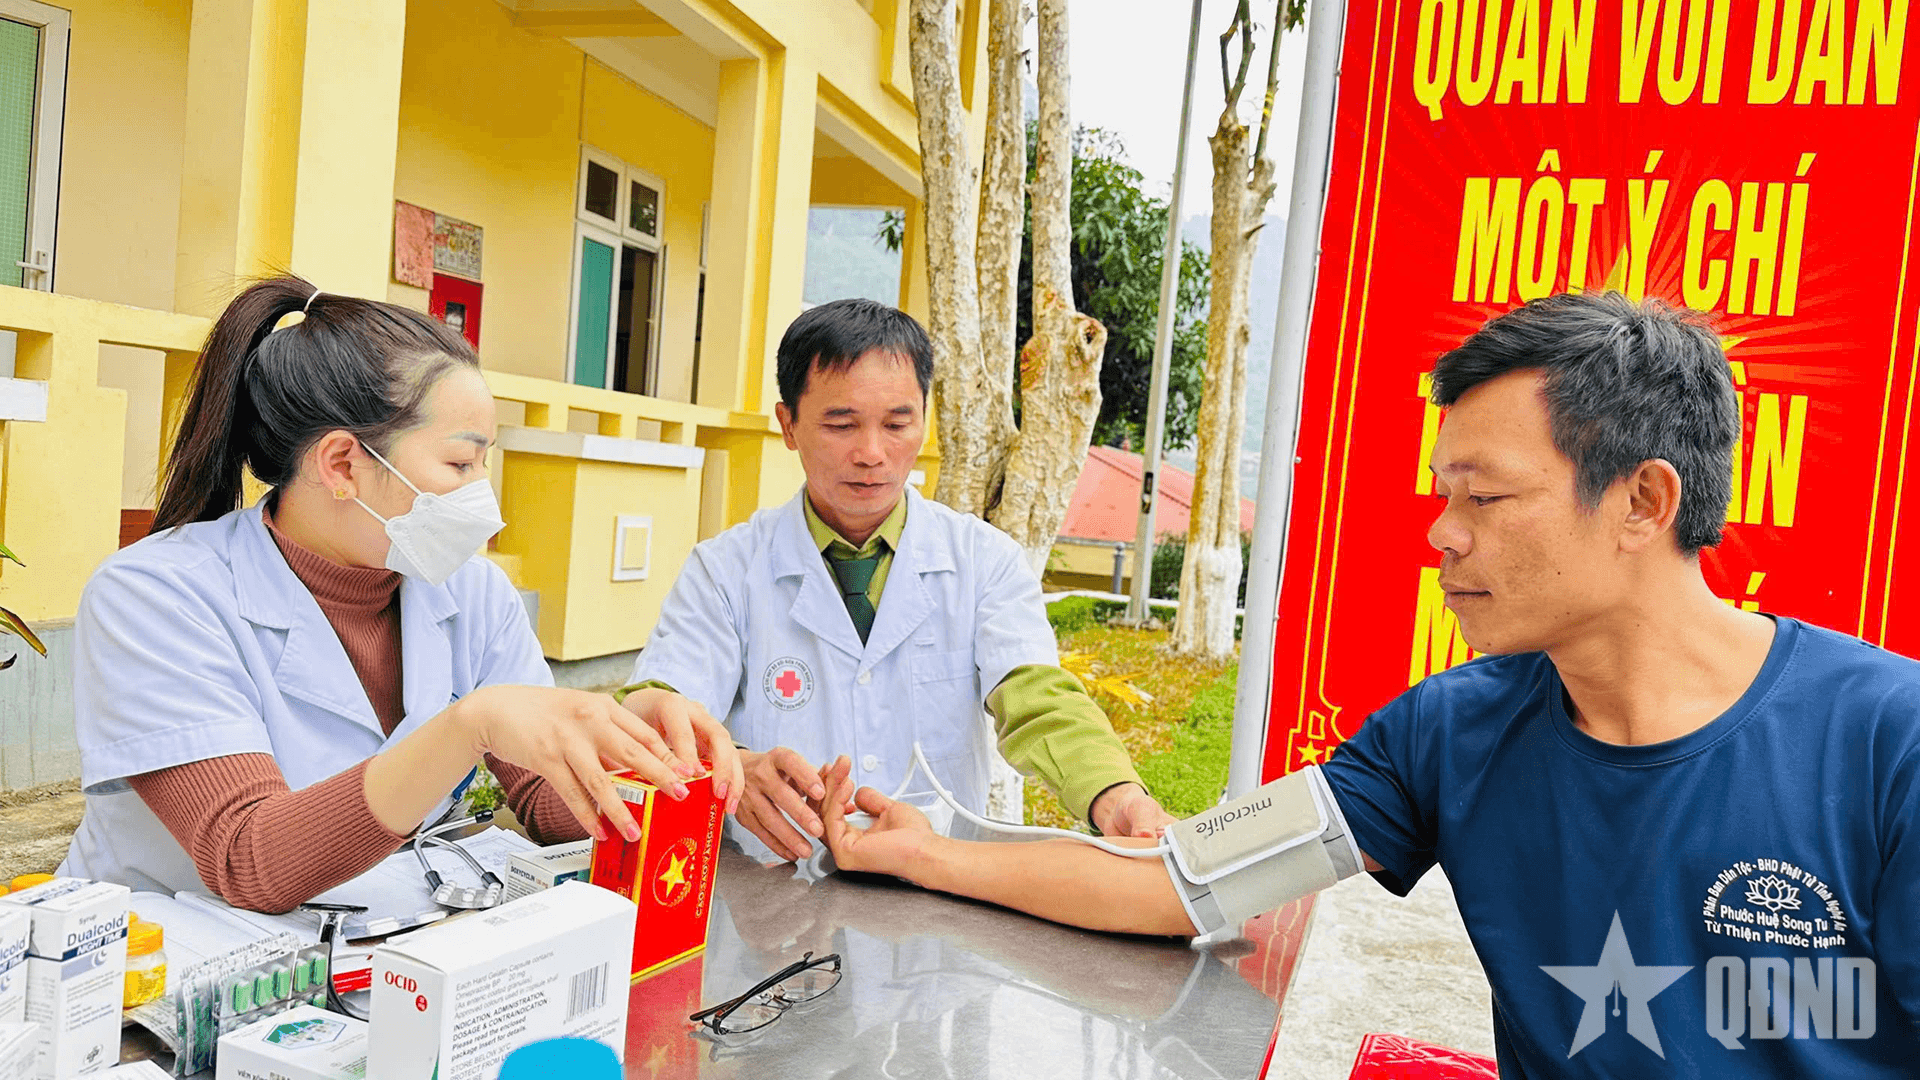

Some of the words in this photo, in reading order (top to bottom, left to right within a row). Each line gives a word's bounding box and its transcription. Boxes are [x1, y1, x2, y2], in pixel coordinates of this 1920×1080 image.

[1626, 150, 1670, 306] Ý
[1682, 152, 1817, 316] CHÍ
[1195, 797, 1272, 836] microlife
[1707, 880, 1726, 897] Ban
[1757, 858, 1779, 873] BHD
[67, 915, 124, 947] Dualcold
[1704, 919, 1722, 935] Từ
[1723, 923, 1762, 943] Thiện
[1765, 930, 1810, 948] Phước
[1813, 934, 1846, 949] Hạnh
[1720, 904, 1755, 923] Phước
[1756, 911, 1780, 929] Huệ
[1782, 914, 1813, 935] Song
[1814, 918, 1829, 932] Tu
[384, 970, 417, 993] OCID
[452, 1024, 481, 1042] DOSAGE
[452, 1039, 473, 1051] Please
[474, 1032, 488, 1042] read
[489, 1027, 499, 1036] the
